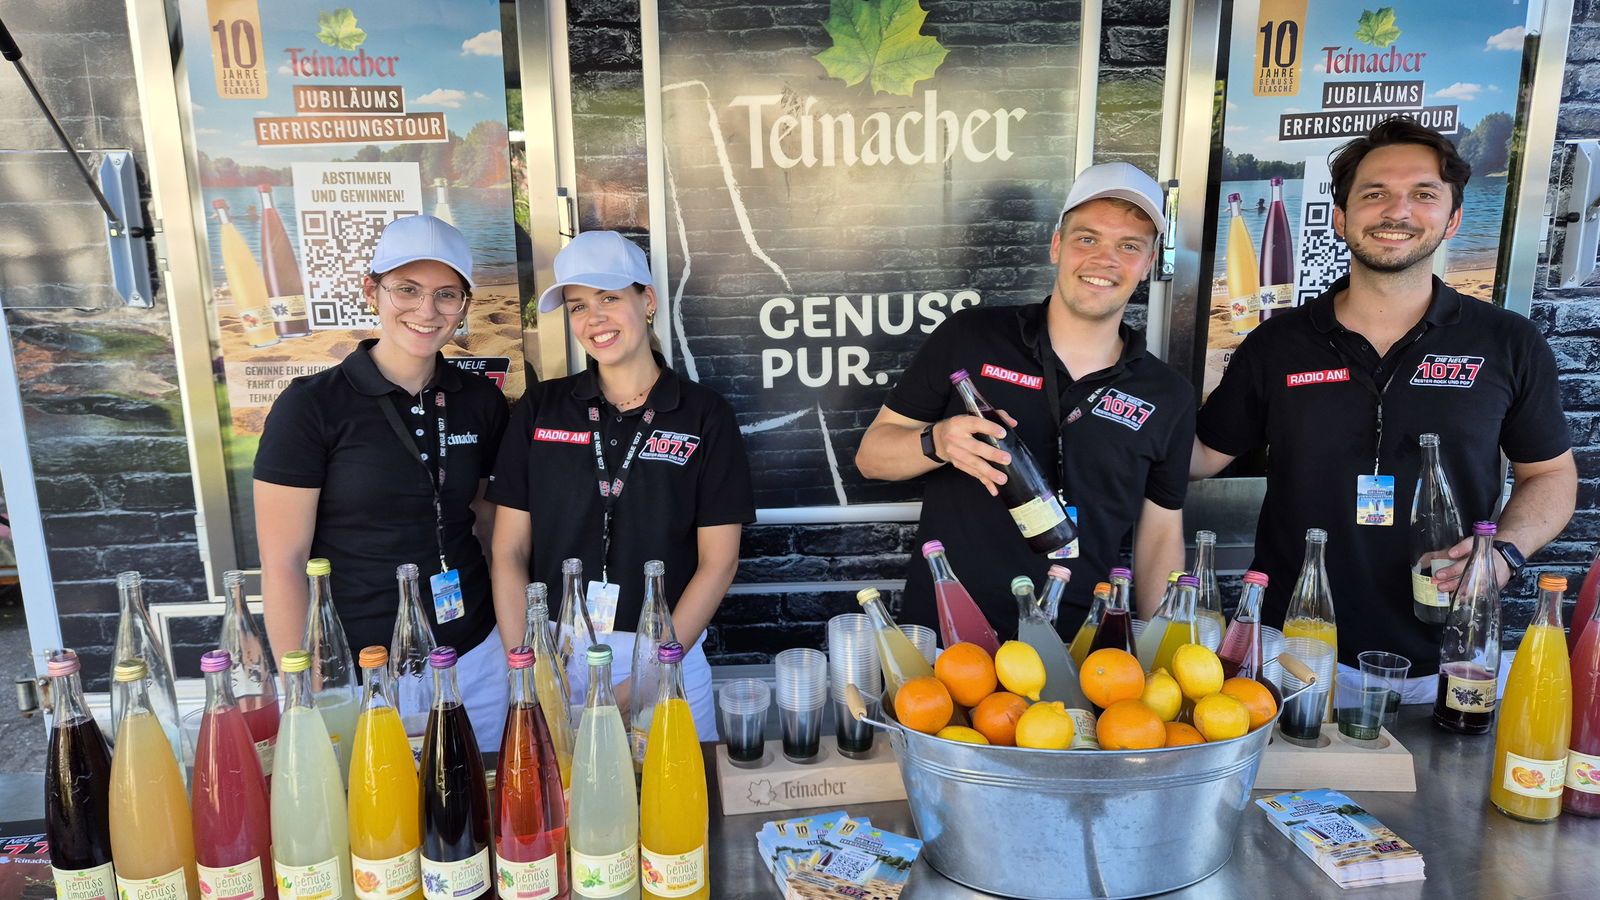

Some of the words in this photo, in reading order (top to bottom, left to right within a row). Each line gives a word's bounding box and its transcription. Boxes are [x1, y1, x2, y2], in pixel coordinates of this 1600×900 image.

[213, 19, 257, 69] 10
[1260, 20, 1298, 67] 10
[284, 48, 400, 78] Teinacher
[1321, 46, 1426, 75] Teinacher
[223, 69, 259, 80] JAHRE
[1260, 68, 1294, 78] JAHRE
[223, 79, 260, 87] GENUSS
[1258, 85, 1293, 93] FLASCHE
[224, 87, 261, 95] FLASCHE
[299, 87, 400, 110] JUBILÄUMS
[1325, 82, 1419, 105] JUBILÄUMS
[259, 117, 442, 142] ERFRISCHUNGSTOUR
[728, 90, 1028, 168] Teinacher
[322, 171, 392, 185] ABSTIMMEN
[312, 189, 337, 202] UND
[341, 189, 405, 202] GEWINNEN!
[1319, 183, 1331, 195] UN
[245, 366, 285, 376] GEWINNE
[286, 366, 304, 375] EINE
[457, 360, 487, 370] NEUE
[761, 345, 889, 388] PUR.
[1418, 362, 1480, 381] 107.7
[247, 379, 275, 389] FAHRT
[277, 379, 291, 389] OD
[985, 365, 1019, 382] RADIO
[1019, 375, 1041, 388] AN!
[1290, 373, 1324, 384] RADIO
[1327, 370, 1347, 381] AN!
[249, 393, 280, 403] TEINAC
[1101, 396, 1150, 424] 107.7
[447, 431, 478, 446] einacher
[537, 430, 570, 441] RADIO
[570, 432, 589, 442] AN!
[646, 437, 697, 458] 107.7
[782, 778, 847, 799] Teinacher
[796, 825, 808, 834] 10
[842, 823, 855, 833] 10
[452, 864, 484, 881] Genuss
[516, 868, 550, 883] Genuss
[667, 861, 698, 876] Genuss
[66, 877, 103, 891] Genuss
[215, 872, 252, 889] Genuss
[295, 871, 331, 888] Genuss
[67, 887, 104, 900] Limonade
[137, 883, 176, 900] Genuss
